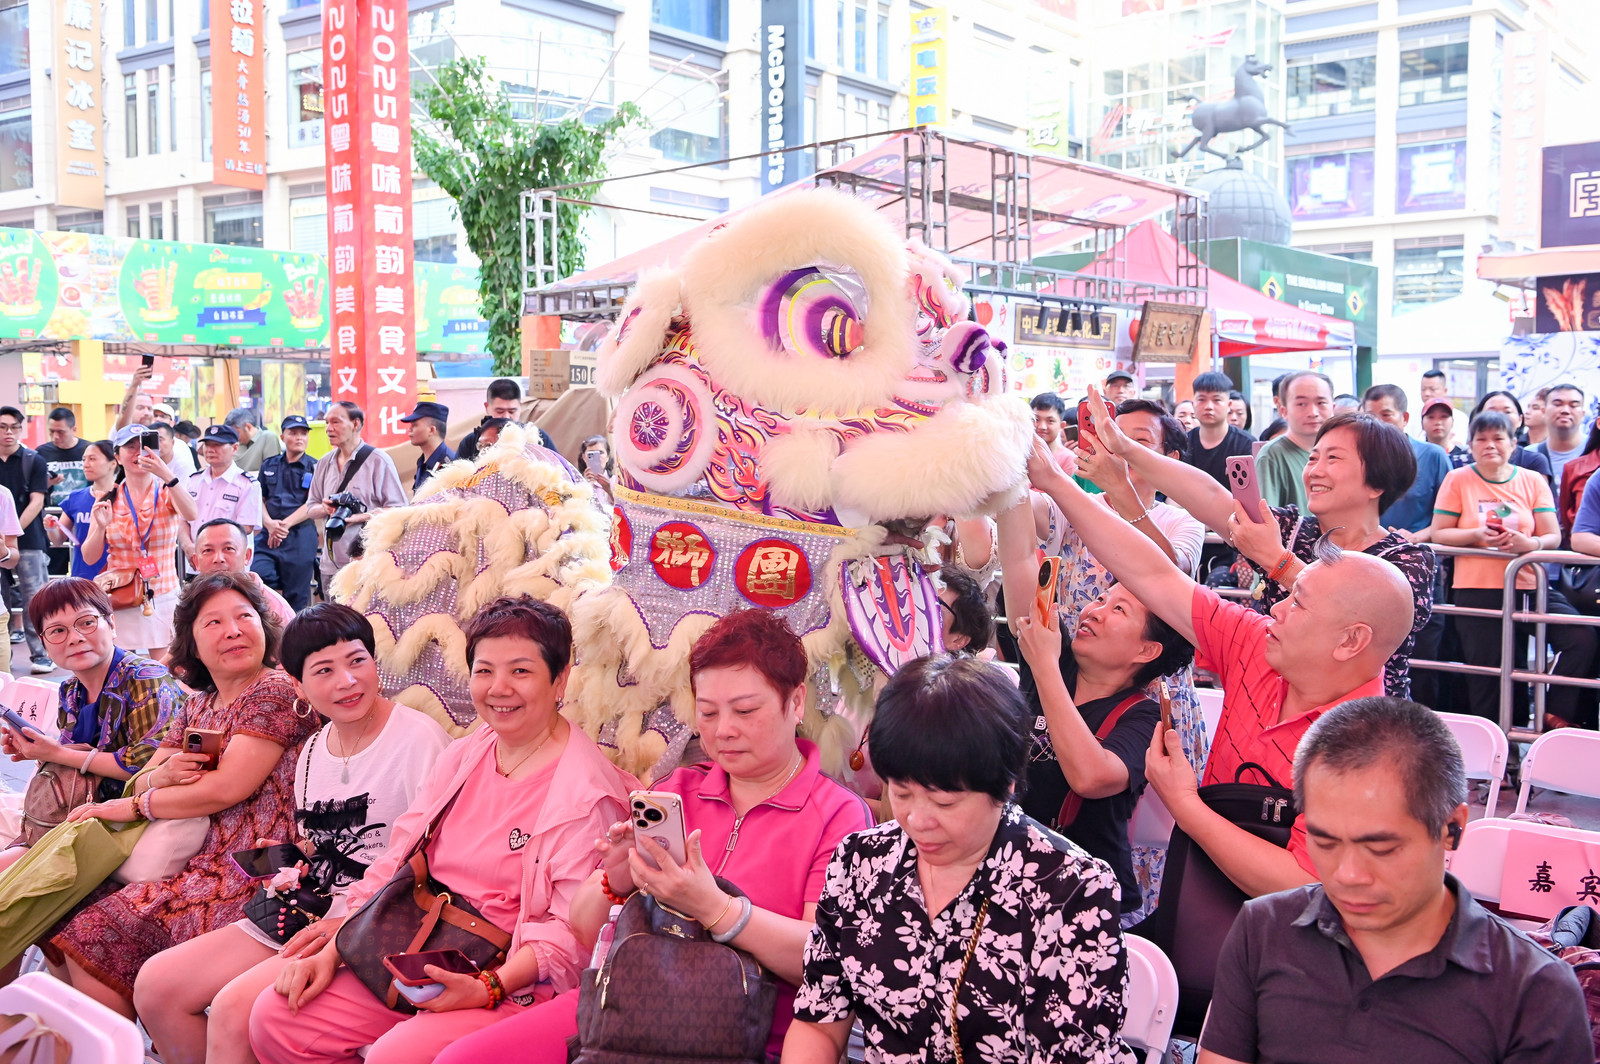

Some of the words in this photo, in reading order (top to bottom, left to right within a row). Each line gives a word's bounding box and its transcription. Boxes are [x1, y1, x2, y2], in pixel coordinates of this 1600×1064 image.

[767, 24, 786, 186] McDonald's
[371, 4, 408, 436] 2025粤味葡韵美食文化
[571, 367, 588, 383] 150
[1528, 860, 1600, 906] 嘉宾
